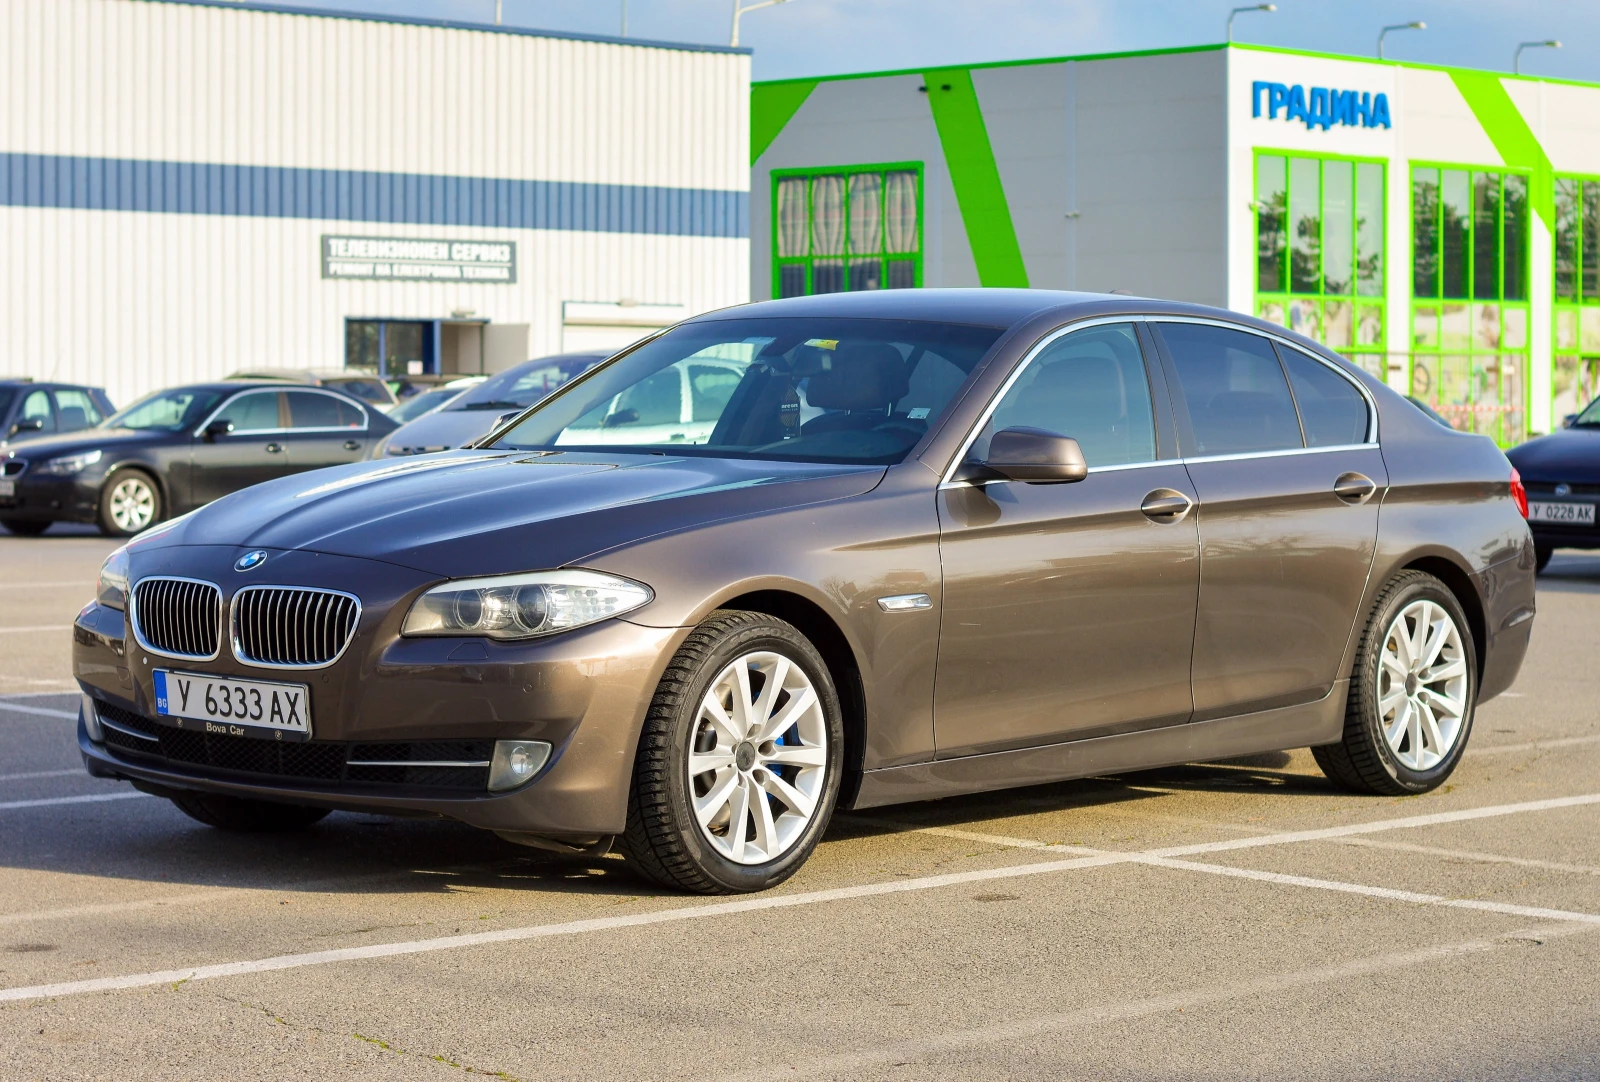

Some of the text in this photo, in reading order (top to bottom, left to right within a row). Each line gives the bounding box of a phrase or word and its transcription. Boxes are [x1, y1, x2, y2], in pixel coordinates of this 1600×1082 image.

[1252, 81, 1391, 131] ГРАДИНА
[451, 242, 511, 262] СЕРВИЗ
[157, 697, 167, 709] BG
[205, 683, 263, 721] 6333
[270, 691, 302, 726] AX
[206, 722, 245, 736] Bova Car
